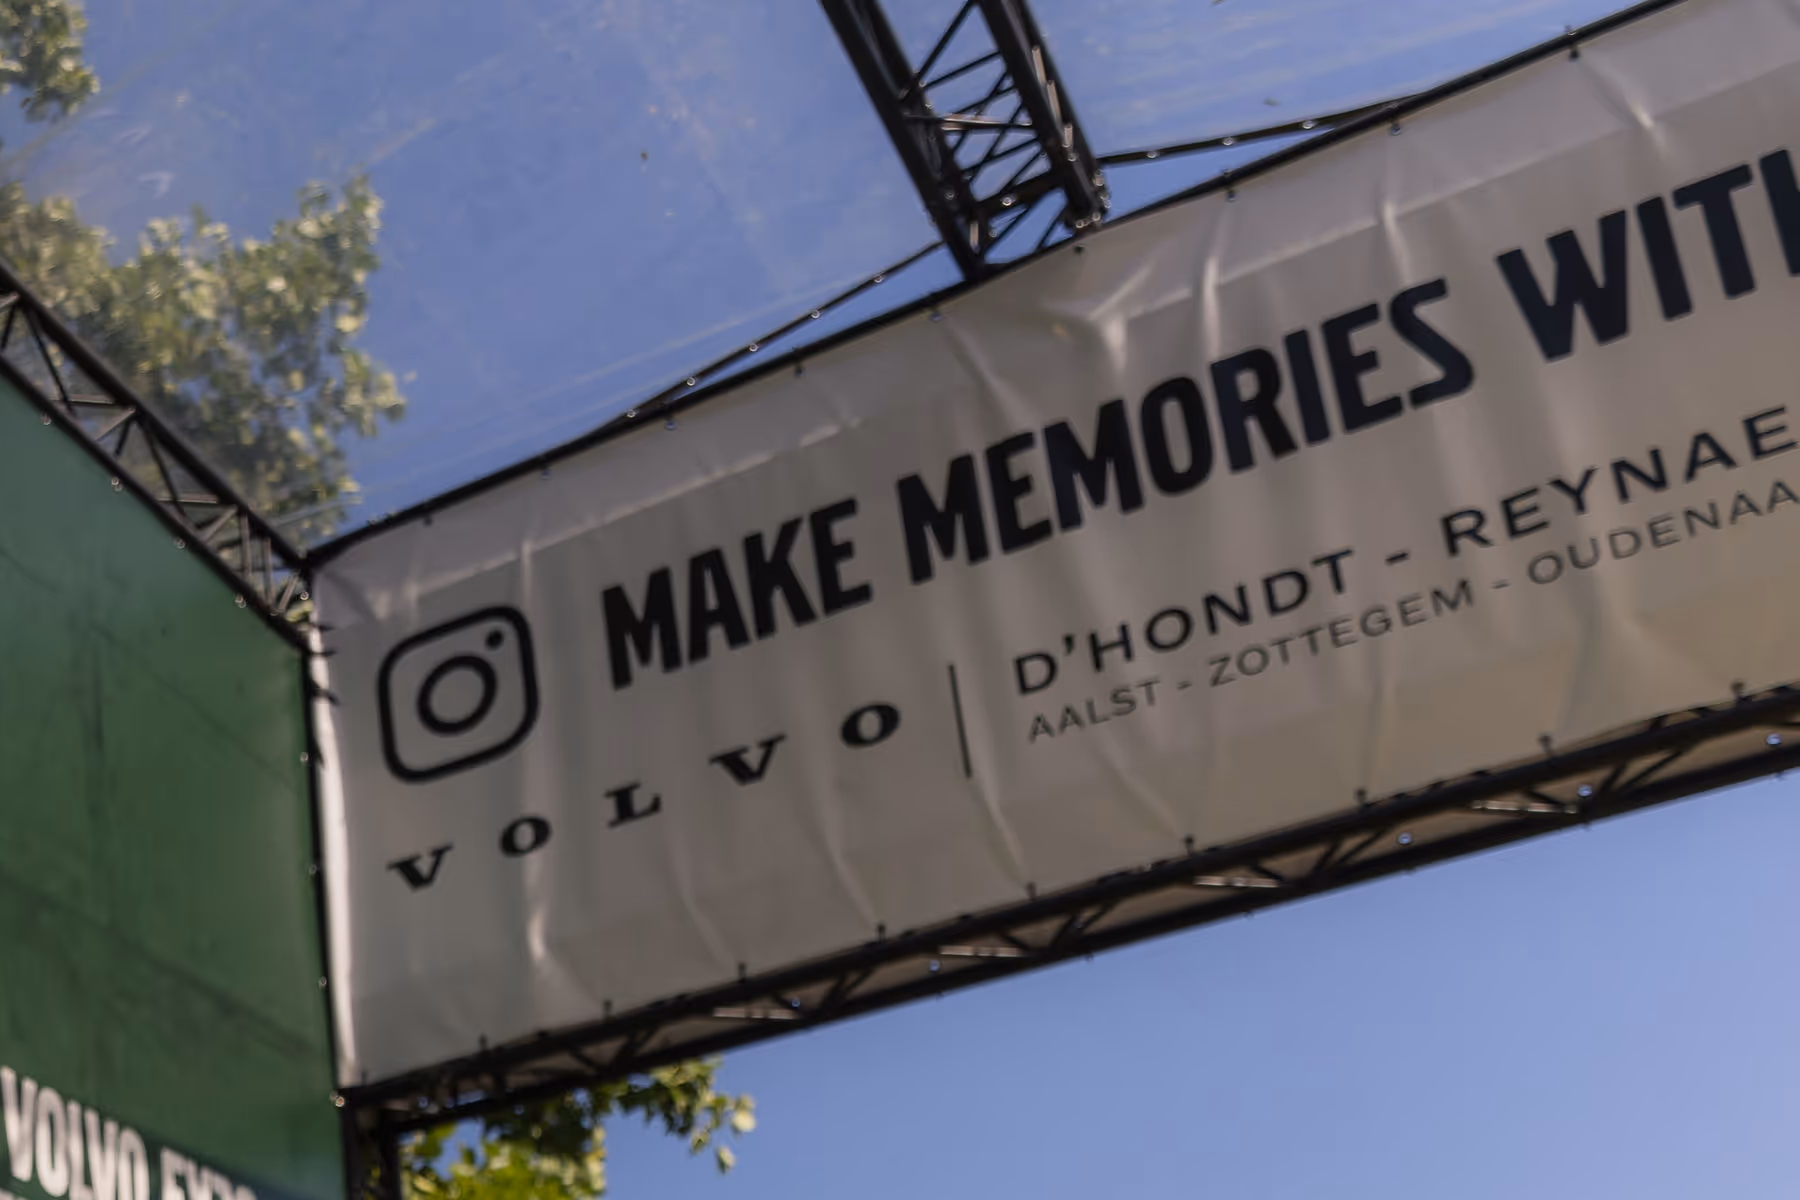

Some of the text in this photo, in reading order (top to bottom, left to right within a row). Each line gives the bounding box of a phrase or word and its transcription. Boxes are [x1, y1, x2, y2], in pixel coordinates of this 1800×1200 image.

[602, 498, 873, 690] MAKE
[896, 278, 1474, 585] MEMORIES
[1012, 549, 1353, 695] D'HONDT
[1385, 551, 1409, 565] -
[1028, 679, 1160, 743] AALST
[1209, 579, 1474, 689] ZOTTEGEM
[387, 704, 900, 891] VOLVO
